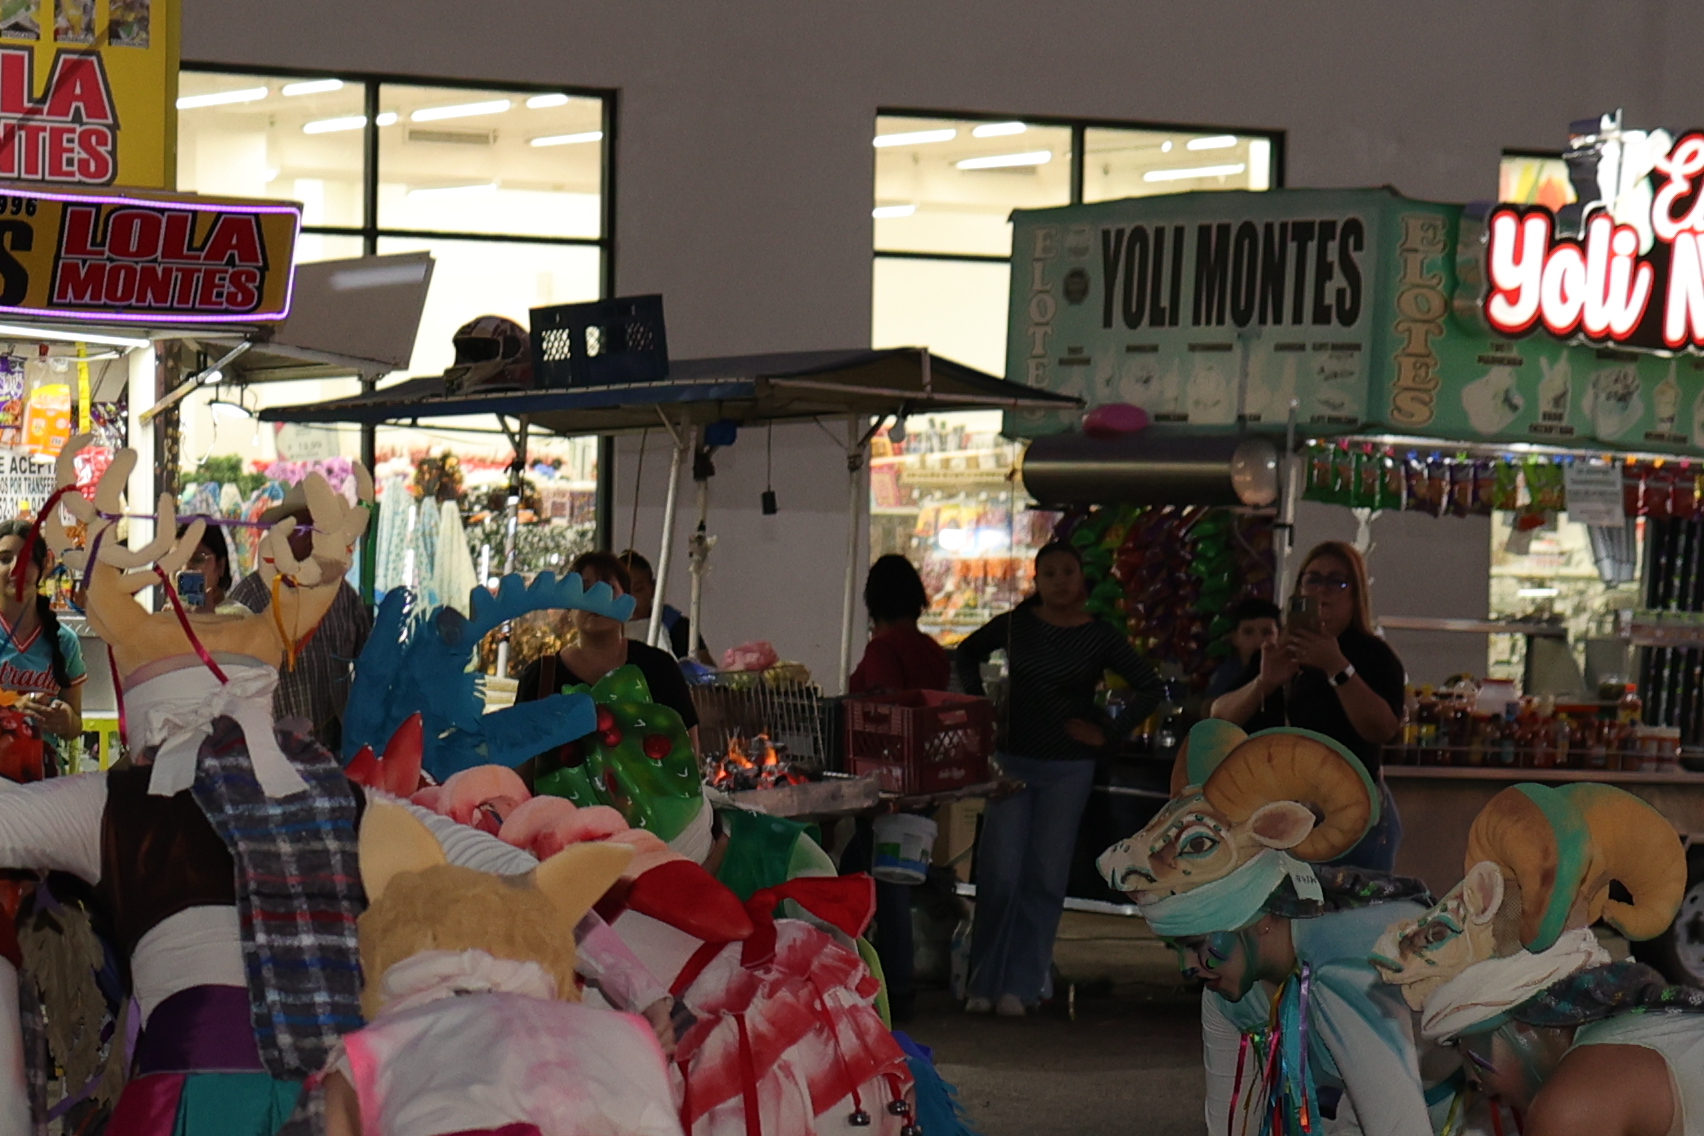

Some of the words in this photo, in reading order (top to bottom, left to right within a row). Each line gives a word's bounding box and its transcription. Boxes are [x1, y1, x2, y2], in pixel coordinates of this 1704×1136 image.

[60, 205, 263, 266] LOLA
[53, 259, 261, 311] MONTES
[1101, 225, 1186, 330] YOLI
[1192, 217, 1366, 328] MONTES
[1389, 215, 1448, 427] ELOTES
[10, 477, 22, 496] POR
